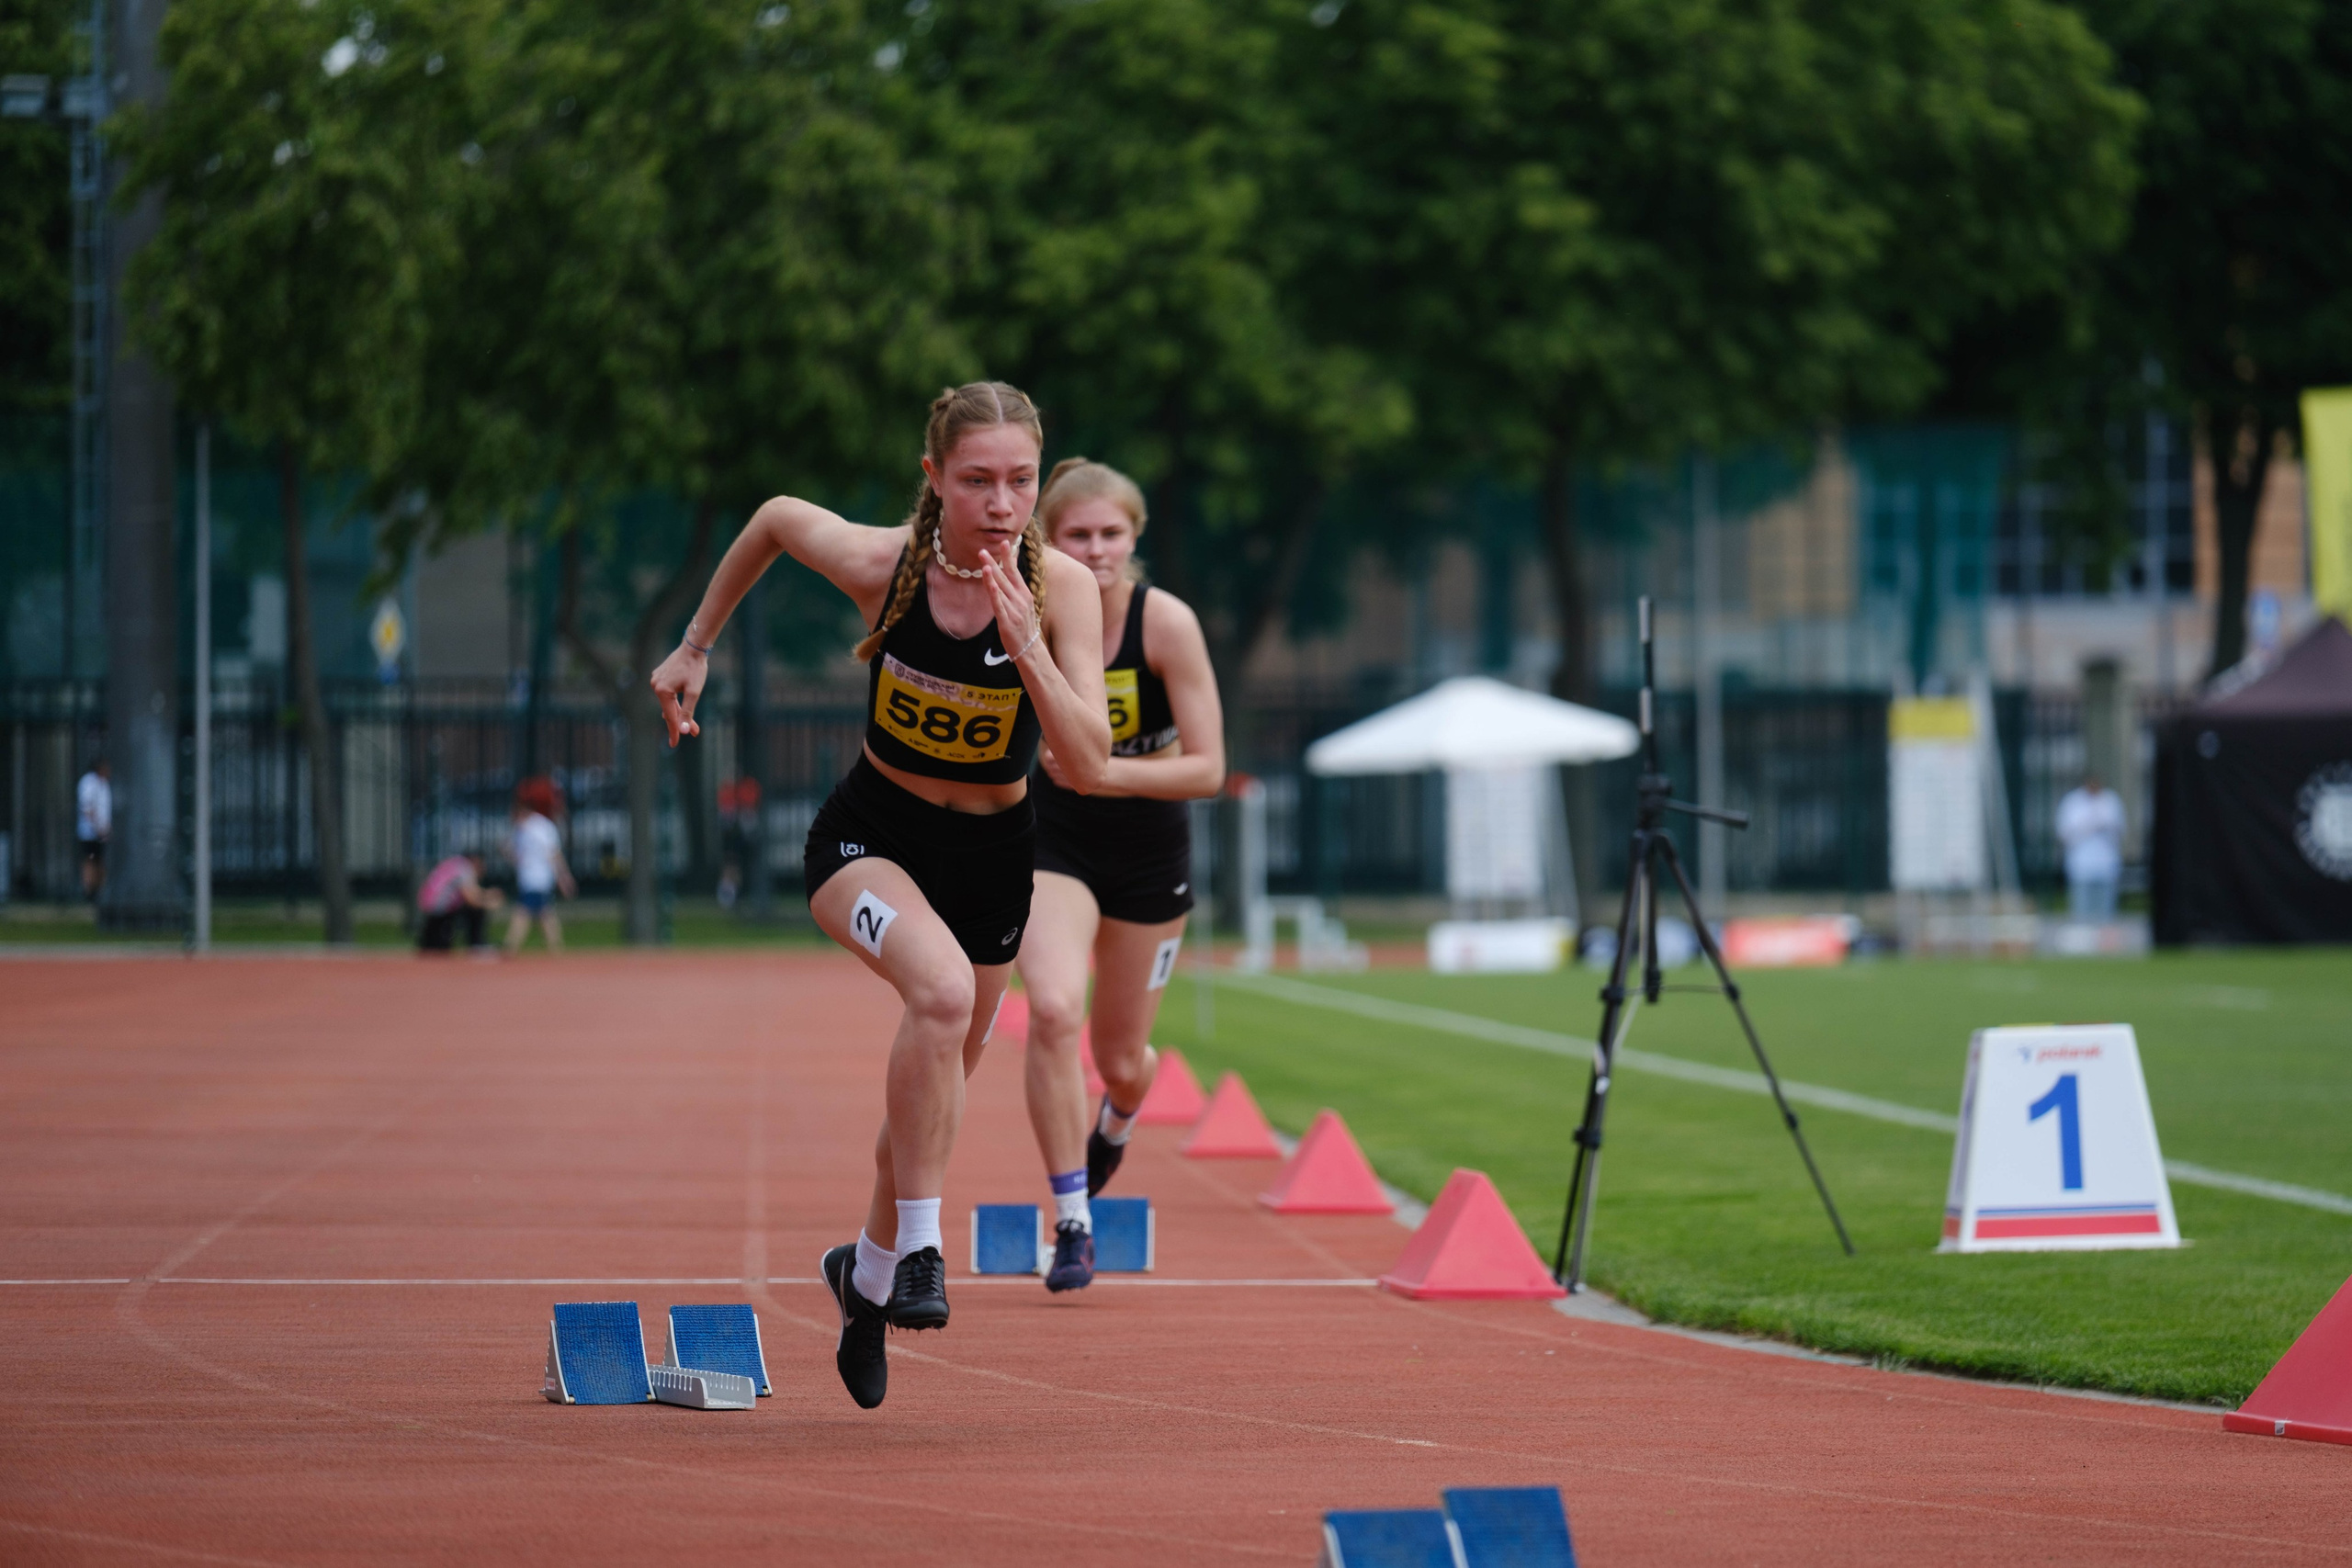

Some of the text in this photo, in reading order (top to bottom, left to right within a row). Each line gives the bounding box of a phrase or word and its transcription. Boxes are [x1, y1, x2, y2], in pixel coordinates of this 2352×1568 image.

[967, 691, 1010, 702] 5 ЭТАП
[886, 689, 1001, 748] 586
[855, 905, 884, 943] 2
[1159, 948, 1171, 979] 1
[2030, 1074, 2083, 1189] 1
